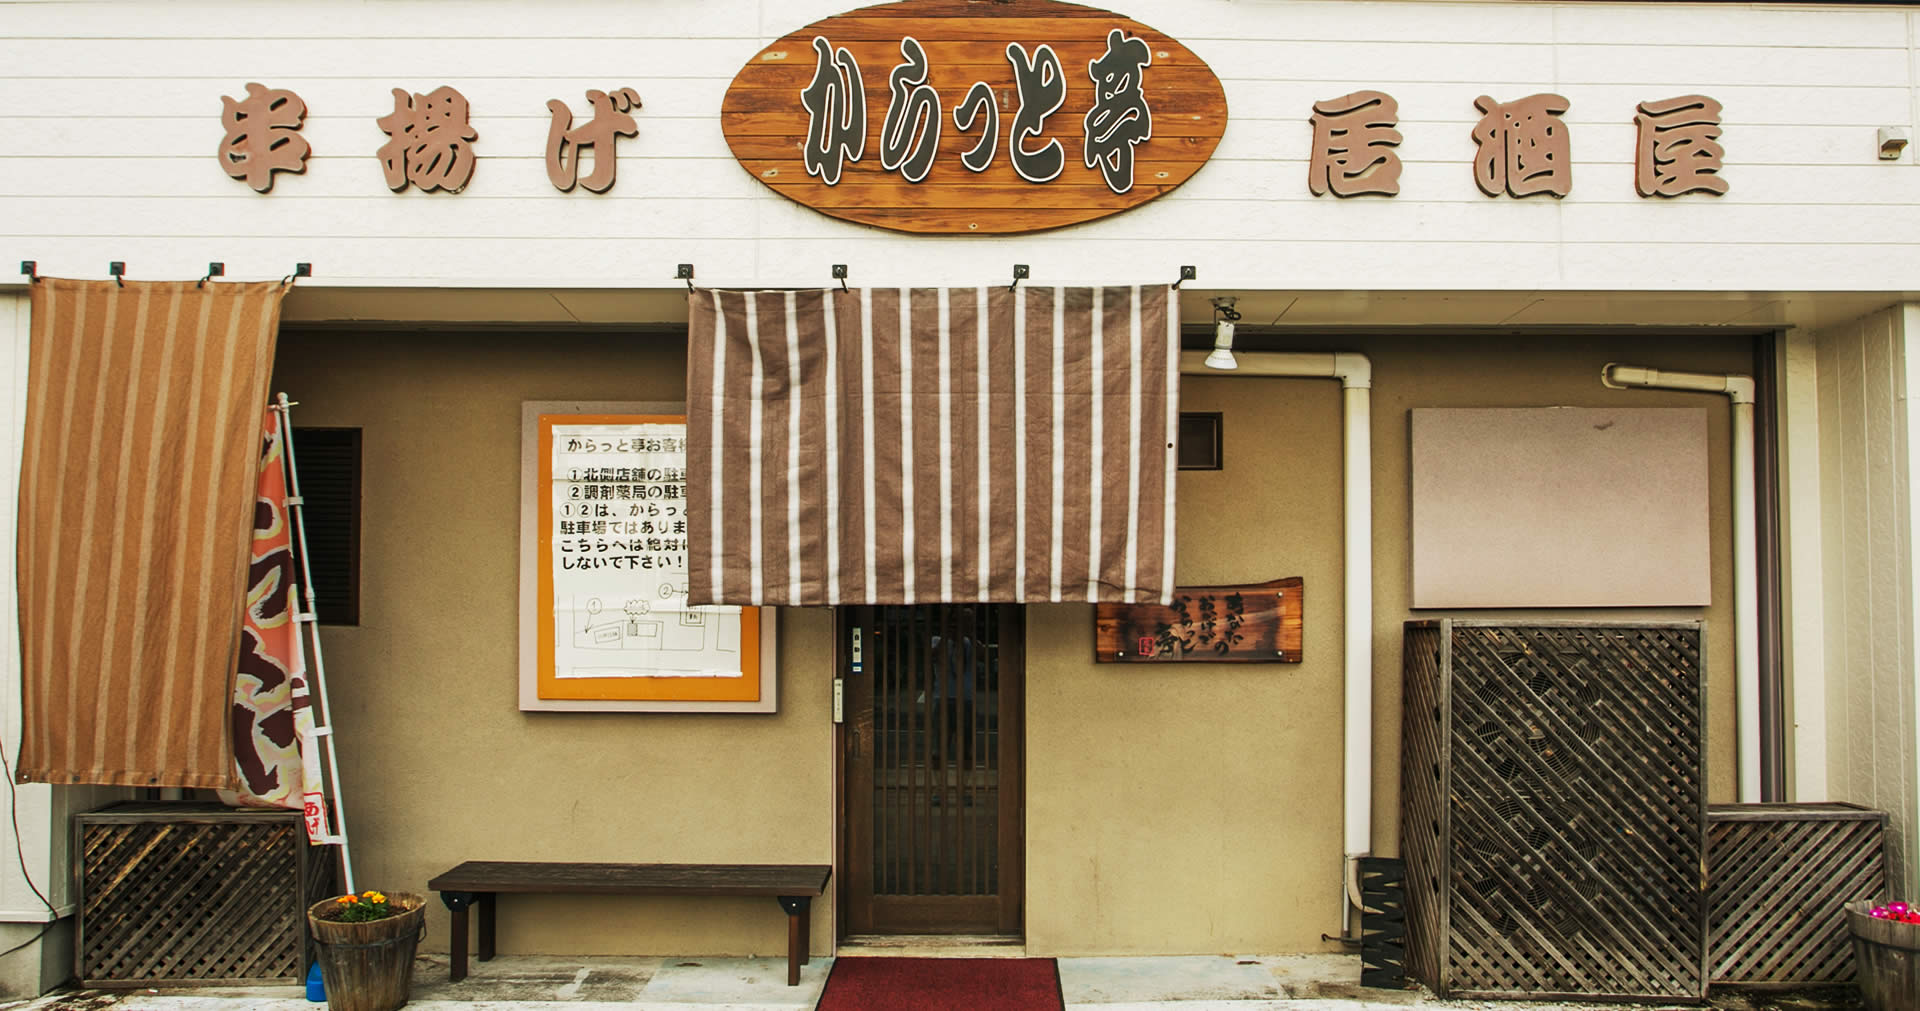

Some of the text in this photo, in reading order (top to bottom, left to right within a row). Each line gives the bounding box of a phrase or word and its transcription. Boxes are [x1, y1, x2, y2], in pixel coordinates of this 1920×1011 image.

[218, 82, 642, 194] 串揚げ
[800, 28, 1152, 194] からっと亭
[1309, 90, 1730, 198] 居酒屋
